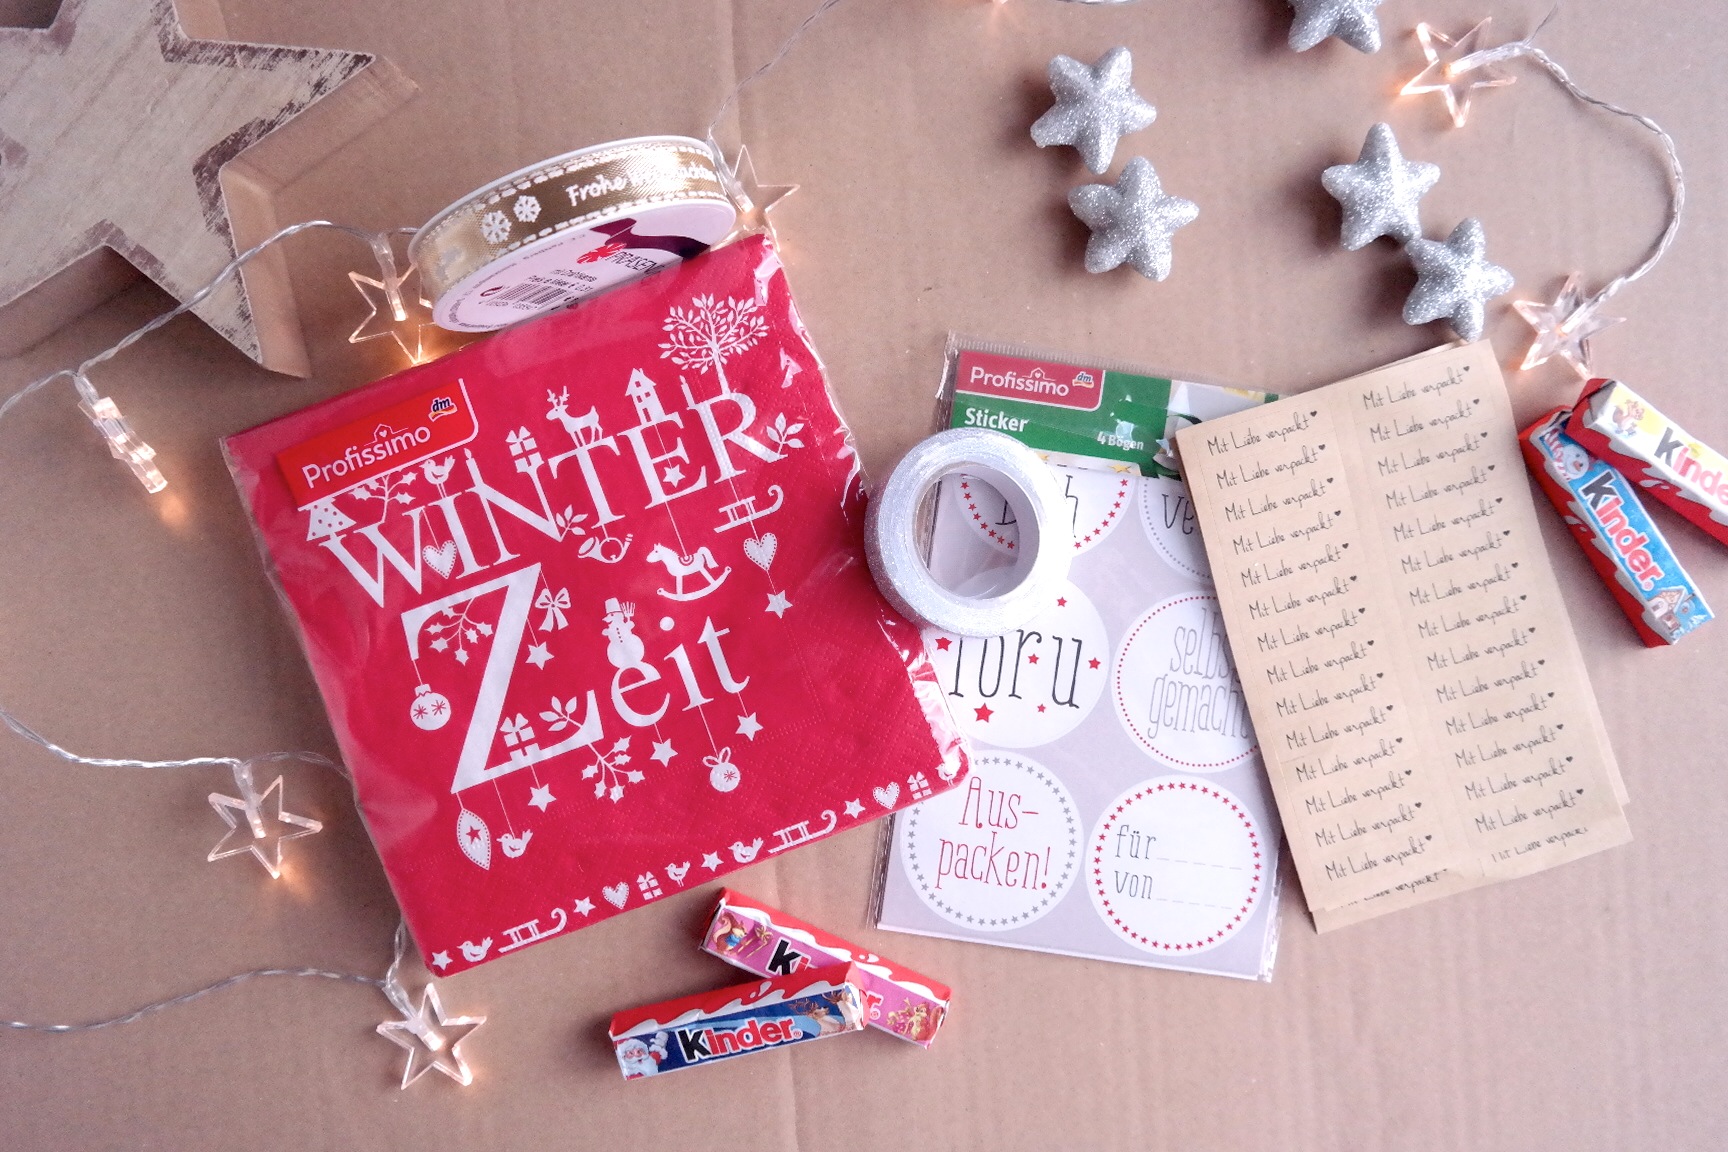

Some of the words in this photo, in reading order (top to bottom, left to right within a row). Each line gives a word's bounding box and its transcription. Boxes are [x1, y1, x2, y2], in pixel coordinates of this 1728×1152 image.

[565, 174, 626, 207] Frohe
[970, 366, 1069, 397] Profissimo
[1076, 372, 1093, 384] dm
[1362, 390, 1384, 410] Mit
[1386, 382, 1416, 403] Liebe
[1421, 366, 1463, 396] verpackt
[432, 397, 451, 413] dm
[964, 407, 1030, 433] Sticker
[1369, 423, 1390, 443] Mit
[1393, 415, 1424, 436] Liebe
[1429, 399, 1472, 429] verpackt
[1097, 432, 1107, 445] 4
[1108, 435, 1144, 451] Bögen
[1207, 435, 1229, 456] Mit
[1230, 427, 1261, 449] Liebe
[1265, 411, 1309, 442] verpackt
[1377, 456, 1399, 476] Mit
[1400, 448, 1431, 470] Liebe
[1435, 433, 1479, 462] verpackt
[302, 427, 431, 489] Profissimo
[1216, 469, 1237, 489] Mit
[1238, 461, 1270, 482] Liebe
[1274, 445, 1318, 475] verpackt
[319, 394, 788, 608] WINTER
[1224, 502, 1246, 522] Mit
[1247, 494, 1278, 515] Liebe
[1282, 478, 1326, 508] verpackt
[1385, 489, 1407, 509] Mit
[1408, 482, 1439, 502] Liebe
[1443, 465, 1487, 495] verpackt
[1232, 535, 1253, 555] Mit
[1255, 527, 1285, 548] Liebe
[1290, 511, 1333, 541] verpackt
[1393, 522, 1414, 542] Mit
[1416, 514, 1446, 535] Liebe
[1450, 498, 1494, 527] verpackt
[1240, 567, 1261, 588] Mit
[1262, 559, 1293, 580] Liebe
[1297, 543, 1341, 573] verpackt
[1401, 555, 1421, 574] Mit
[1423, 547, 1454, 567] Liebe
[1458, 531, 1502, 560] verpackt
[1248, 600, 1270, 620] Mit
[1271, 592, 1301, 613] Liebe
[1305, 576, 1349, 606] verpackt
[1409, 587, 1430, 606] Mit
[1431, 579, 1462, 600] Liebe
[1467, 563, 1510, 592] verpackt
[1257, 632, 1278, 652] Mit
[1279, 624, 1310, 645] Liebe
[1314, 608, 1357, 638] verpackt
[1417, 619, 1439, 638] Mit
[1440, 611, 1471, 632] Liebe
[1475, 596, 1519, 625] verpackt
[1266, 665, 1287, 685] Mit
[1288, 656, 1319, 678] Liebe
[1323, 641, 1367, 670] verpackt
[1426, 652, 1448, 671] Mit
[1449, 644, 1480, 664] Liebe
[1484, 628, 1527, 657] verpackt
[401, 563, 750, 794] Zeit
[1275, 697, 1297, 717] Mit
[1298, 689, 1329, 710] Liebe
[1333, 673, 1376, 703] verpackt
[1436, 684, 1457, 703] Mit
[1458, 676, 1489, 697] Liebe
[1493, 660, 1537, 690] verpackt
[1285, 730, 1307, 750] Mit
[1308, 722, 1339, 743] Liebe
[1343, 706, 1386, 736] verpackt
[1445, 716, 1466, 736] Mit
[1467, 708, 1499, 729] Liebe
[1503, 692, 1547, 722] verpackt
[1295, 762, 1317, 782] Mit
[1318, 754, 1348, 776] Liebe
[1352, 738, 1395, 768] verpackt
[1454, 748, 1476, 768] Mit
[1477, 741, 1507, 761] Liebe
[1512, 725, 1556, 754] verpackt
[1305, 795, 1326, 815] Mit
[1327, 787, 1357, 808] Liebe
[1362, 770, 1405, 800] verpackt
[1464, 781, 1486, 801] Mit
[1486, 773, 1518, 794] Liebe
[1521, 757, 1565, 787] verpackt
[1314, 828, 1335, 847] Mit
[1336, 819, 1367, 840] Liebe
[1371, 803, 1414, 833] verpackt
[1474, 813, 1496, 833] Mit
[1497, 805, 1528, 826] Liebe
[1532, 789, 1576, 819] verpackt
[934, 831, 1051, 889] packen!
[1115, 824, 1157, 859] für
[1324, 860, 1347, 881] Mit
[1347, 852, 1379, 873] Liebe
[1382, 836, 1425, 866] verpackt
[1115, 870, 1153, 900] von
